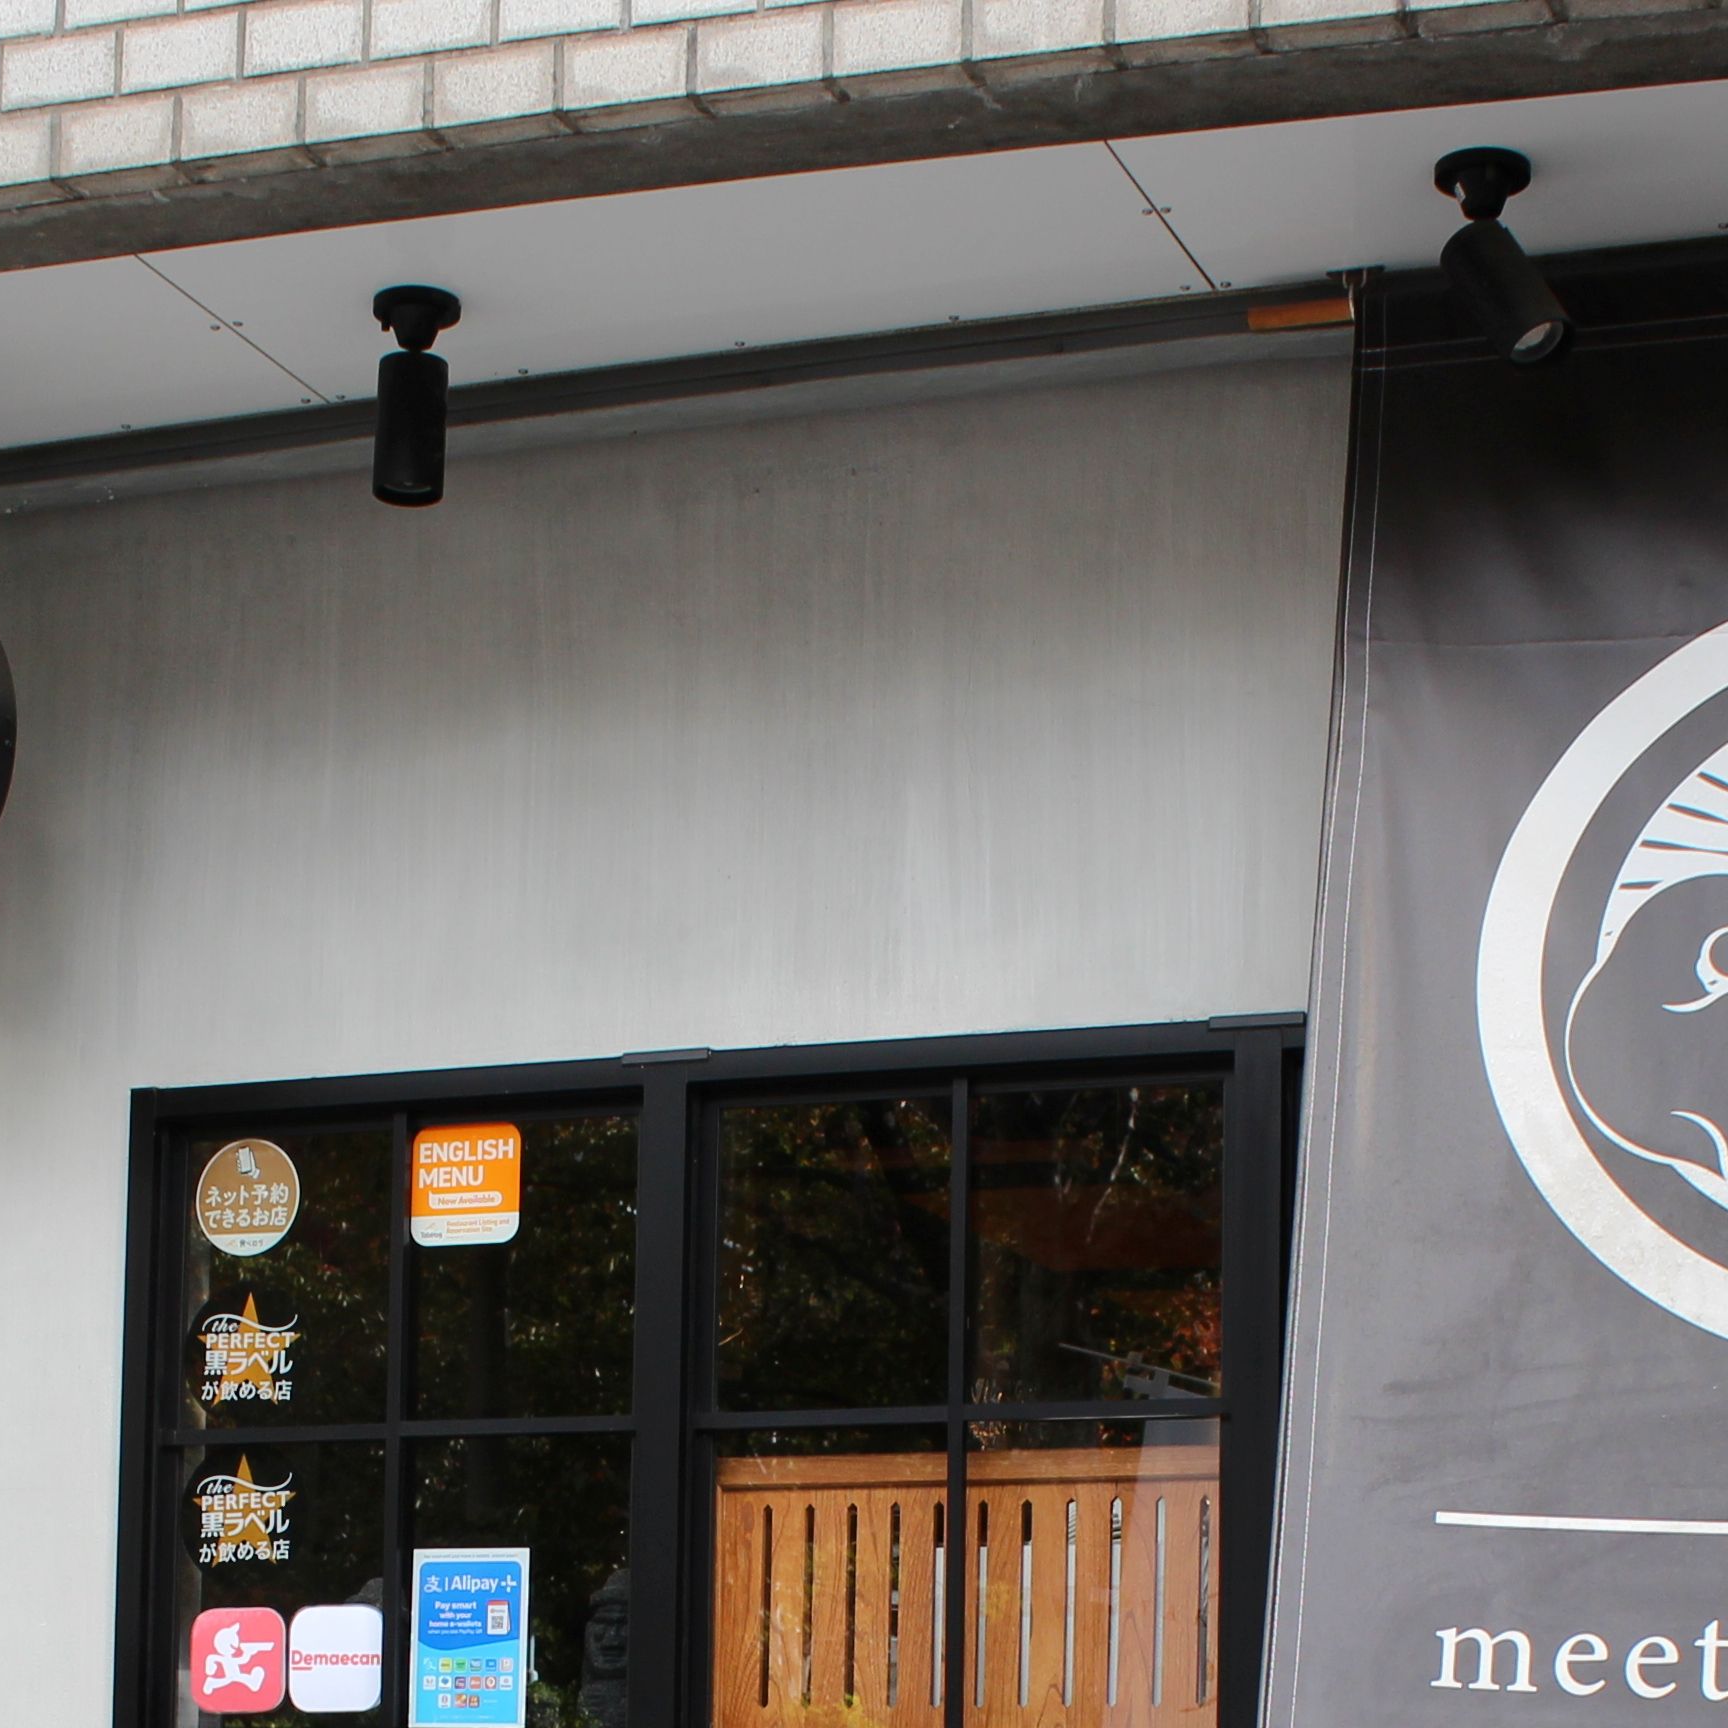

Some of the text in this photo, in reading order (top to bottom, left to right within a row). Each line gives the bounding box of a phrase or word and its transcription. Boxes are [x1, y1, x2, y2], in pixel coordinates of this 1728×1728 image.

[419, 1138, 515, 1164] ENGLISH
[418, 1165, 484, 1189] MENU
[205, 1182, 290, 1207] ネット予約
[205, 1205, 288, 1229] できるお店
[212, 1317, 239, 1332] the
[206, 1332, 295, 1349] PERFECT
[204, 1350, 293, 1375] 黒ラベル
[201, 1380, 292, 1401] が飲める店
[206, 1479, 233, 1494] the
[201, 1491, 290, 1511] PERFECT
[200, 1509, 290, 1538] 黒ラベル
[199, 1539, 290, 1563] が飲める店
[435, 1601, 477, 1611] Pay smart
[291, 1650, 380, 1667] Demaecan
